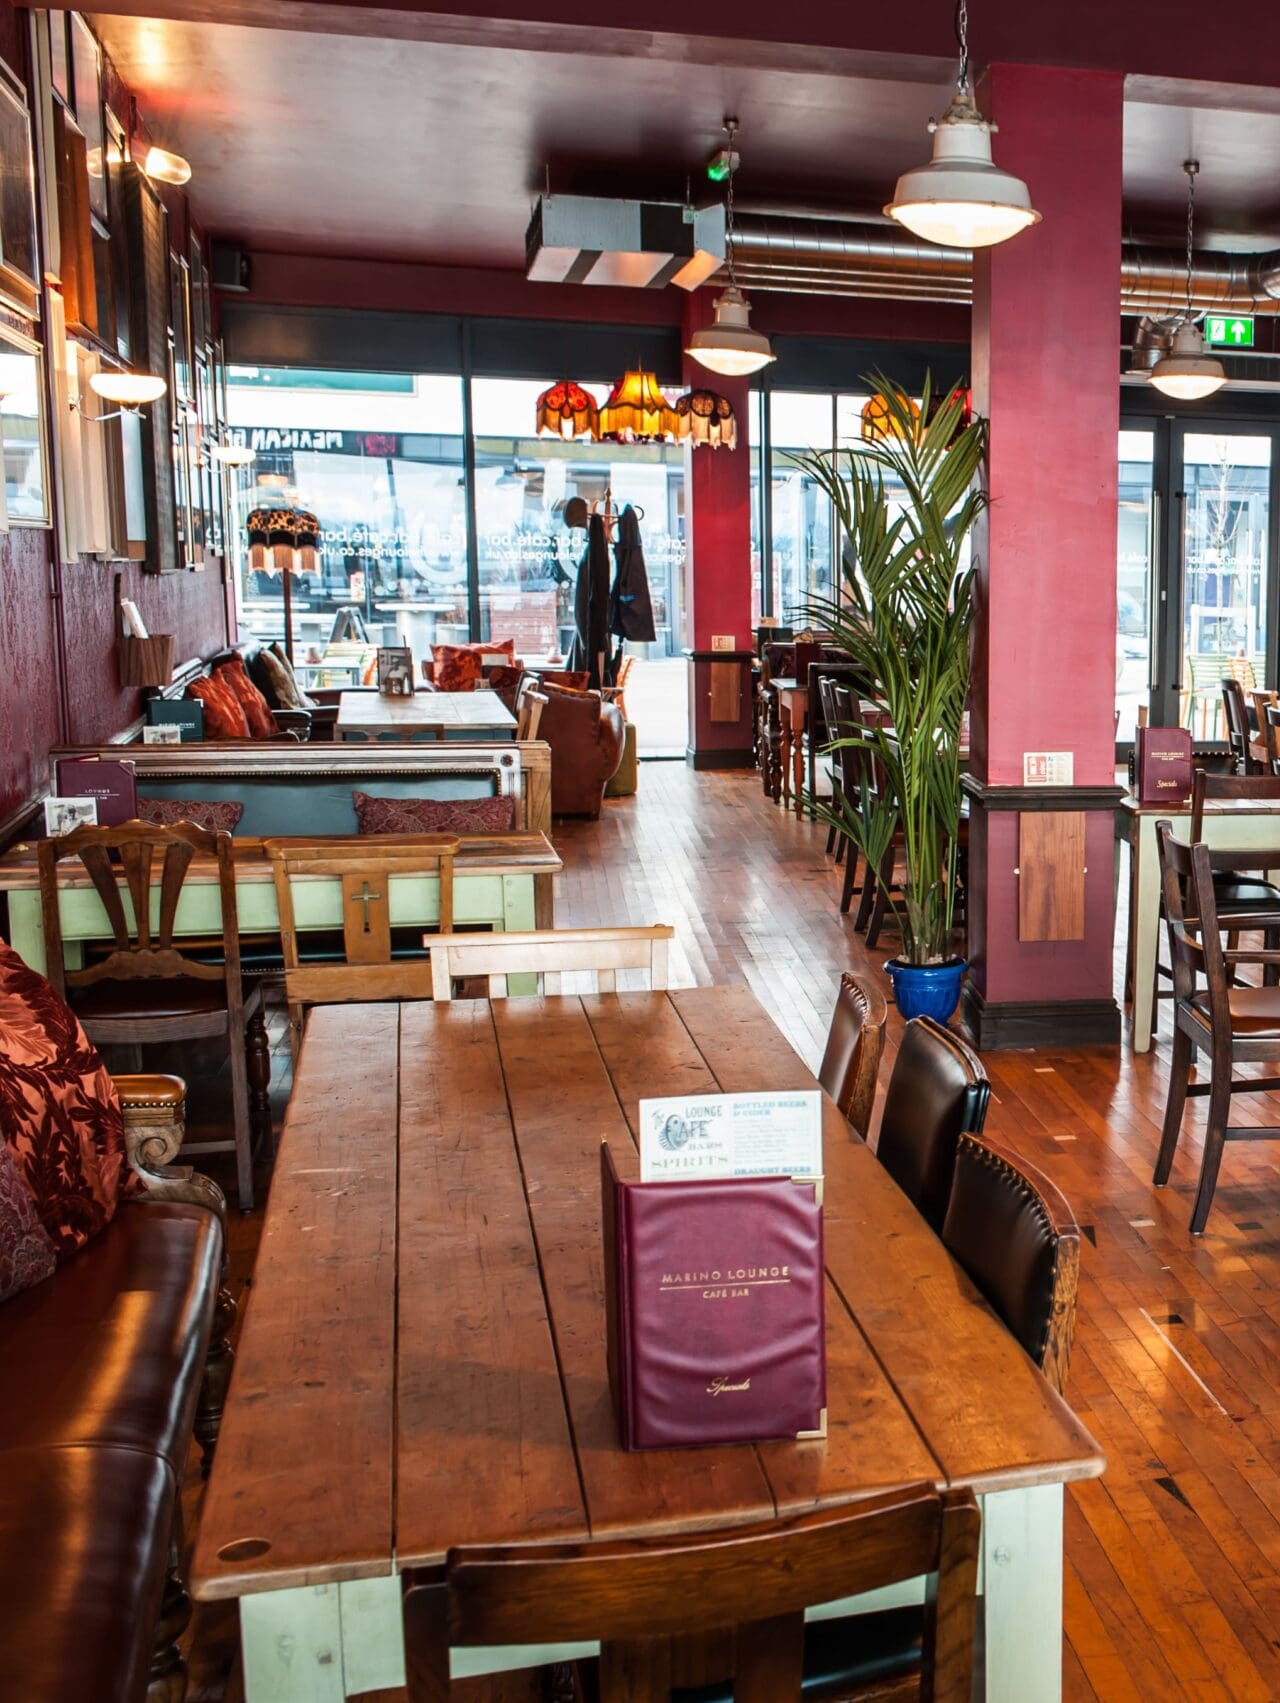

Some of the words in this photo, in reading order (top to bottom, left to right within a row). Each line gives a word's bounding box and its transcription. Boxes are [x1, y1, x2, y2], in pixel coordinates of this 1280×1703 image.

[685, 1104, 723, 1119] LOUNGE
[651, 1155, 729, 1169] SPIRITS
[661, 1270, 721, 1284] MARINO
[727, 1266, 790, 1280] LOUNGE
[731, 1288, 750, 1297] BAR
